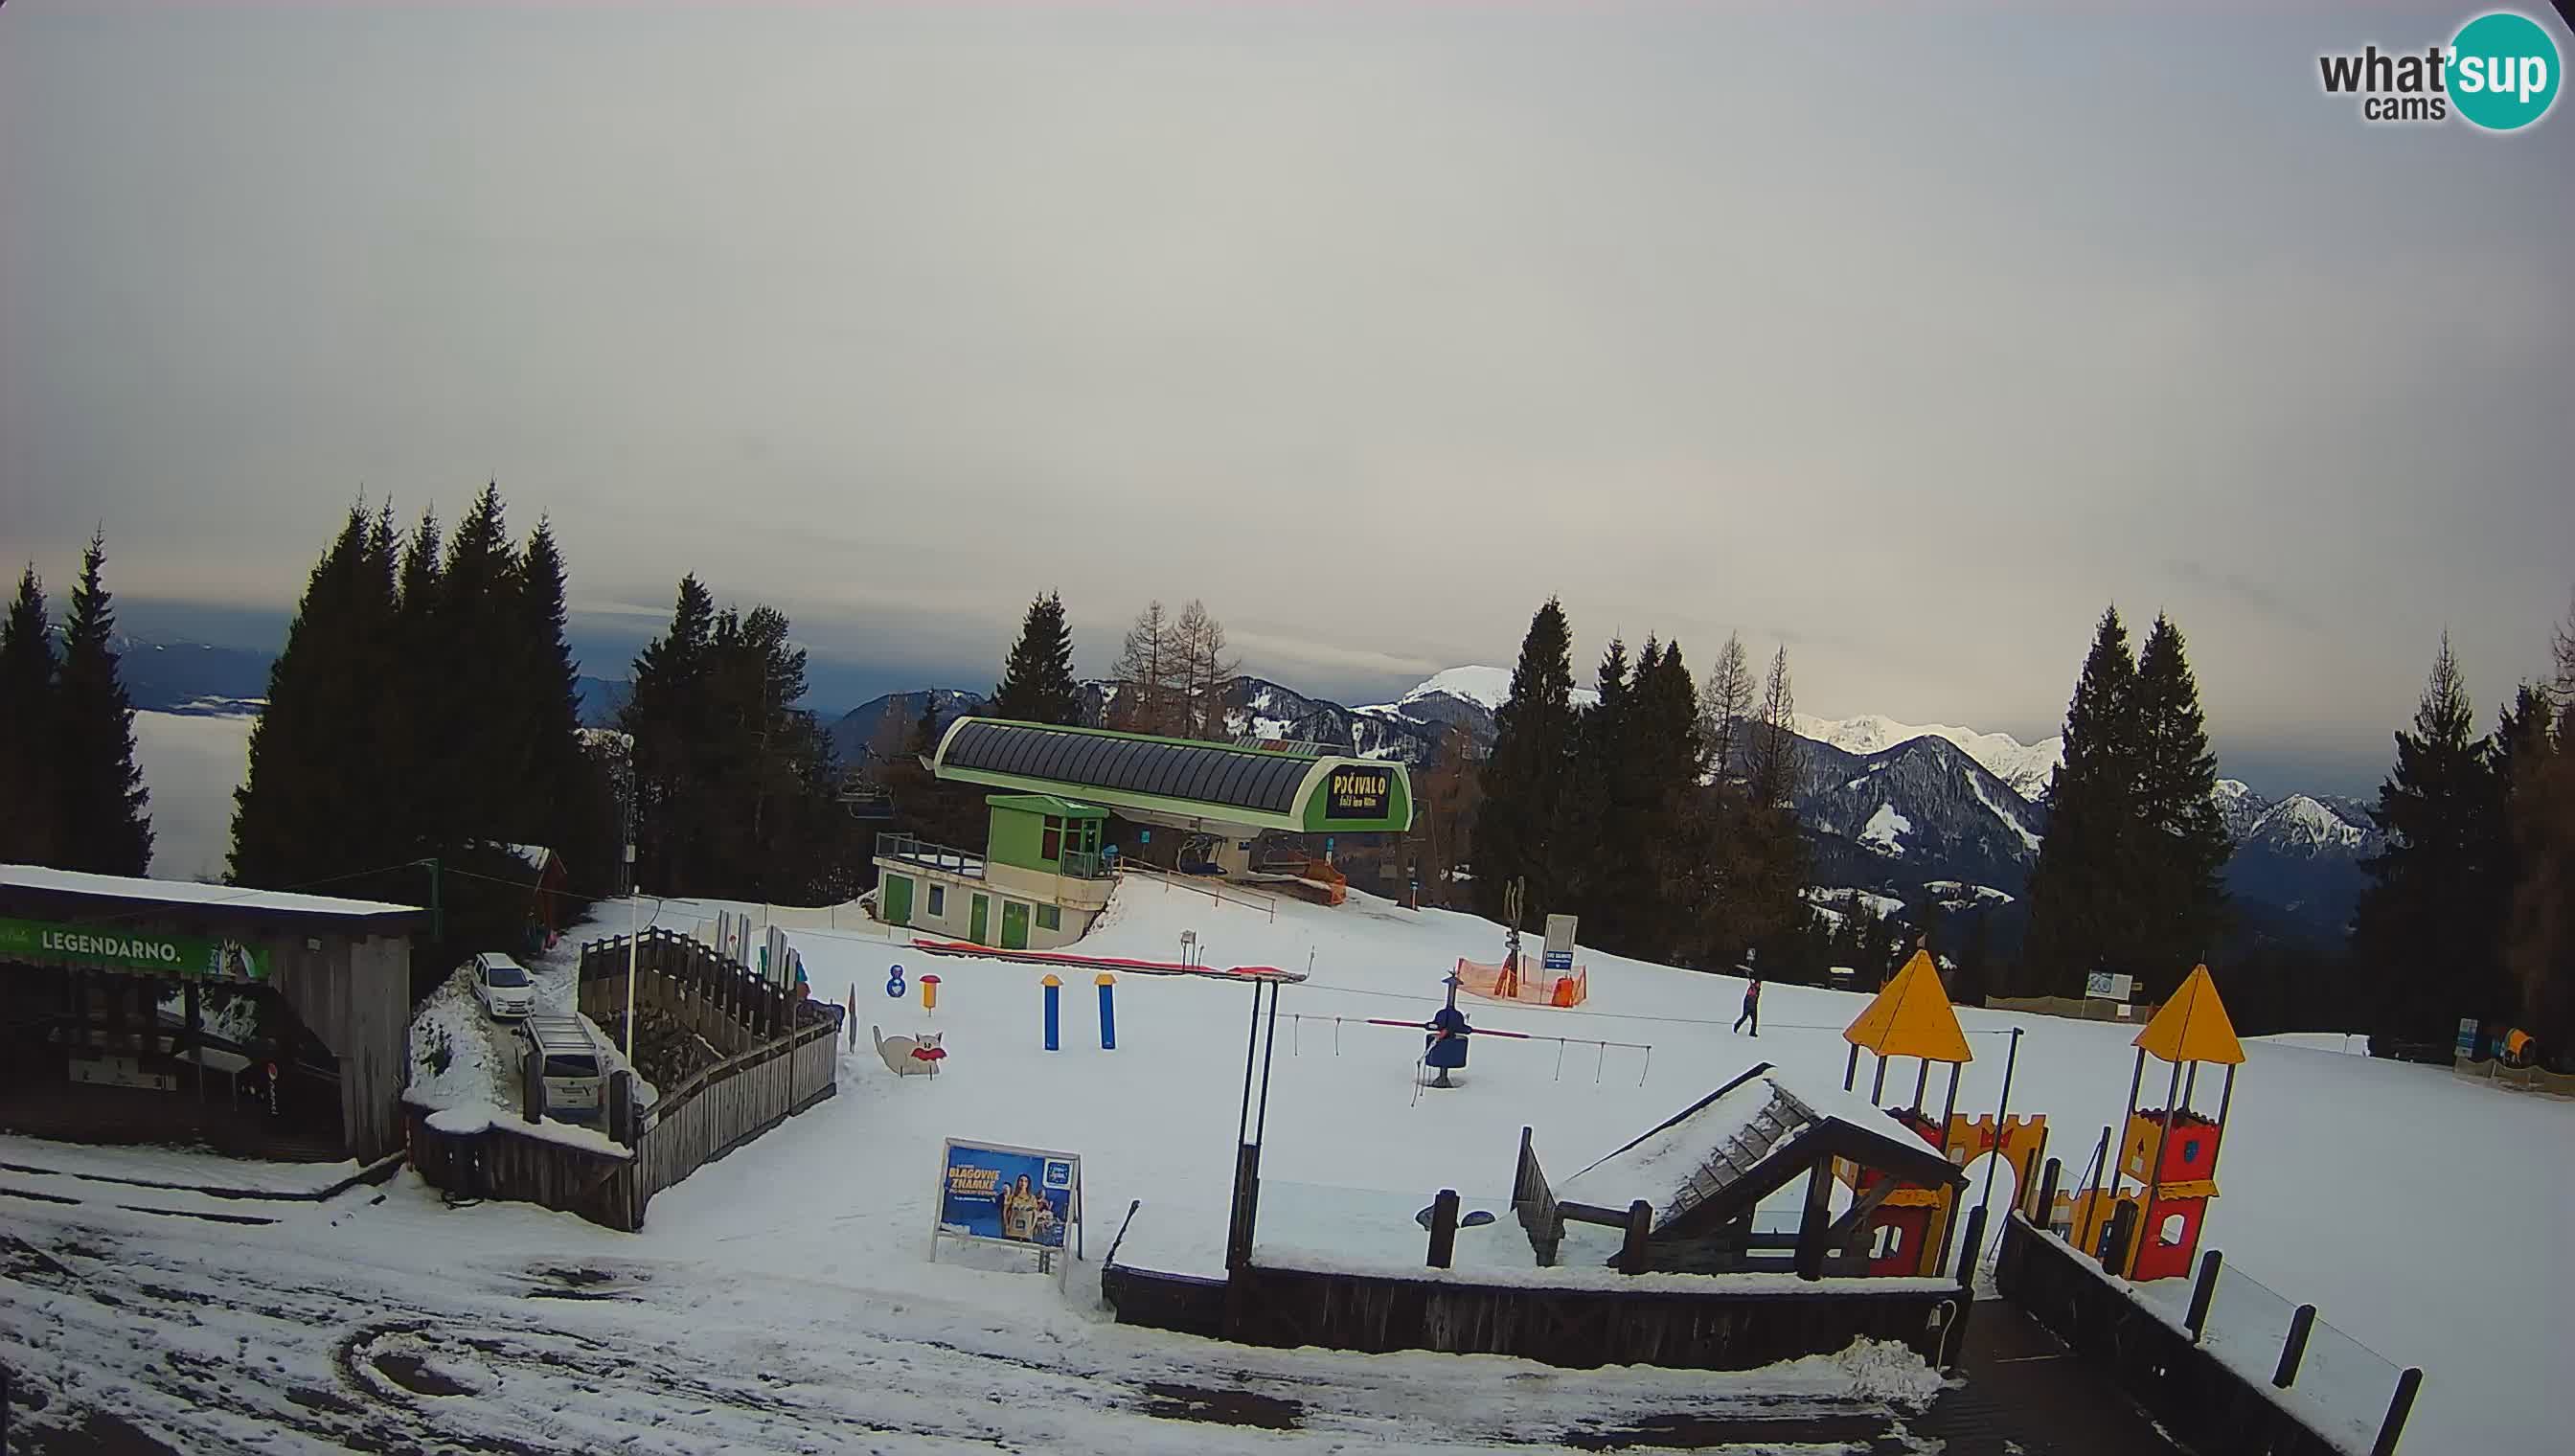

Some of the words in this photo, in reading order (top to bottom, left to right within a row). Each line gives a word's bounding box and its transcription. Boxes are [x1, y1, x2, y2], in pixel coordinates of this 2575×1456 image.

[42, 930, 181, 963] LEGENDARNO.
[949, 1167, 1000, 1180] BLAGOVNE
[951, 1178, 995, 1191] ZNAMKE
